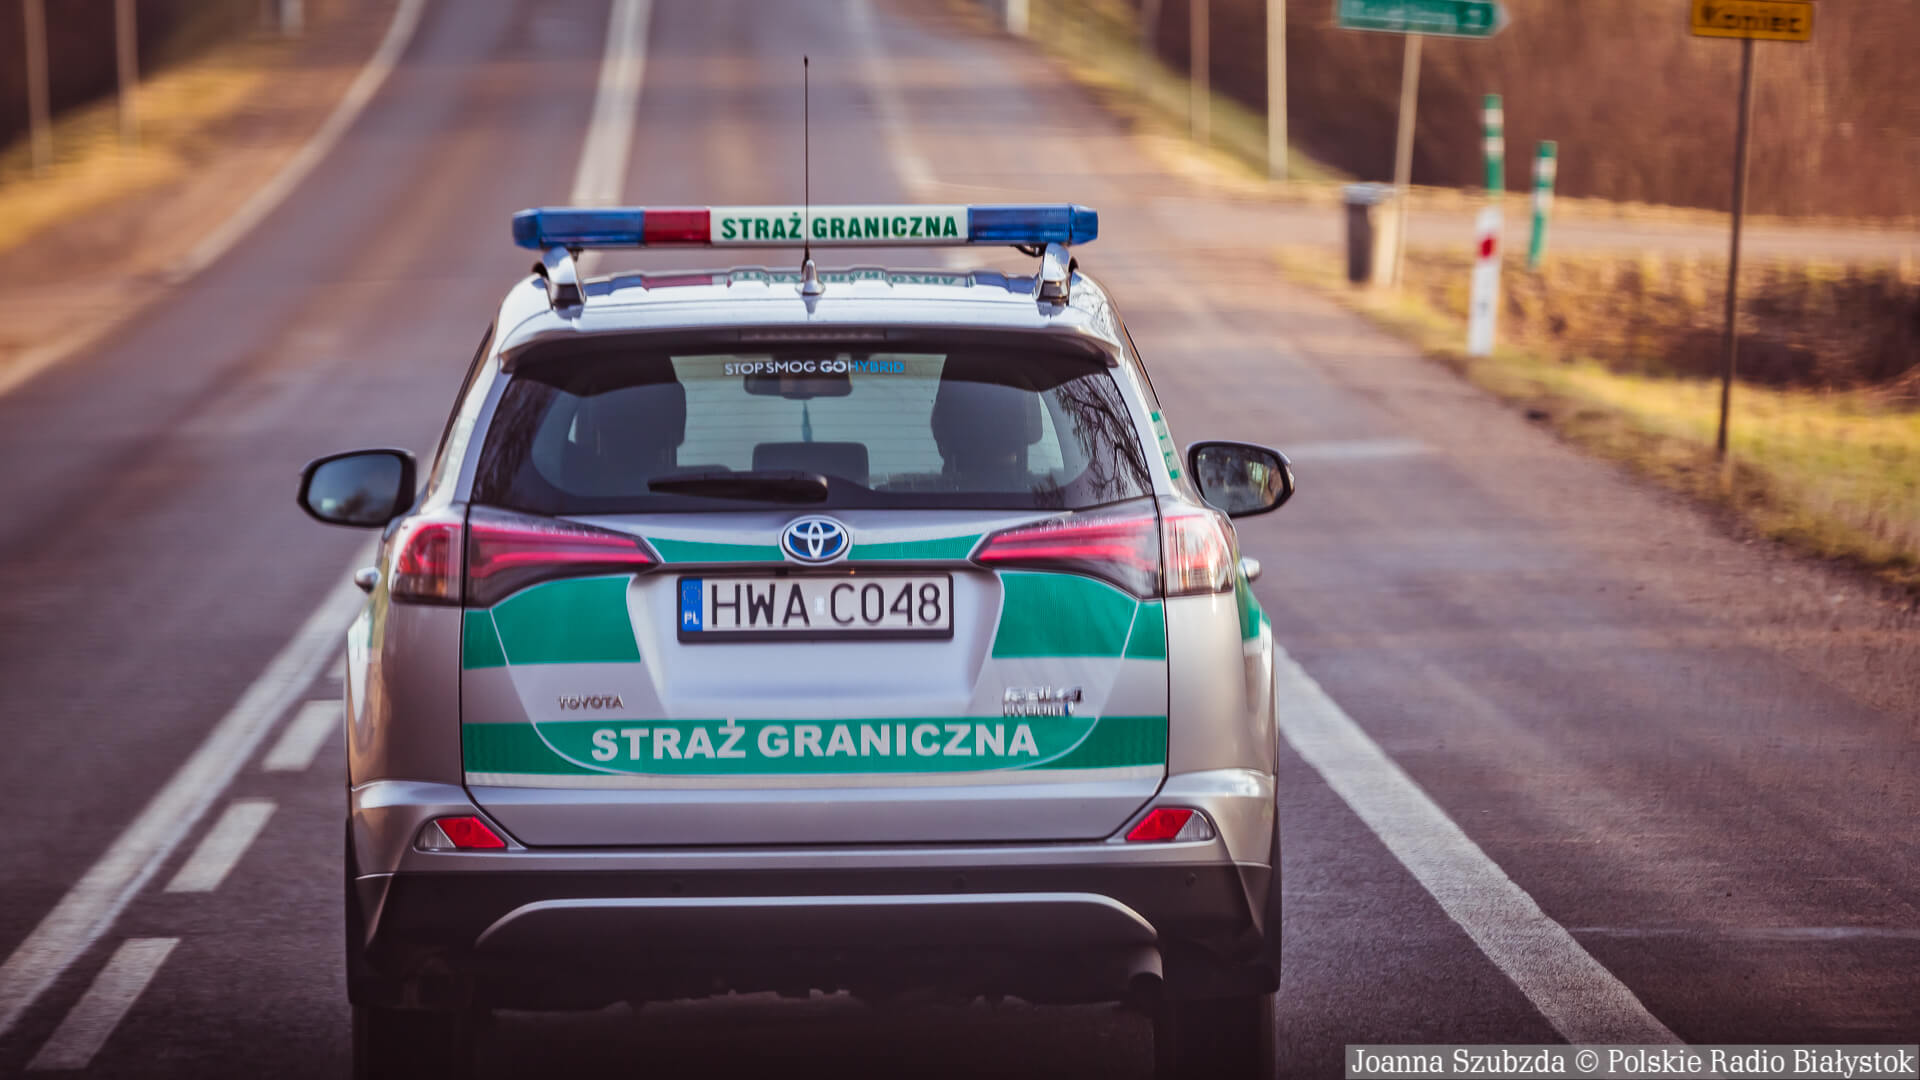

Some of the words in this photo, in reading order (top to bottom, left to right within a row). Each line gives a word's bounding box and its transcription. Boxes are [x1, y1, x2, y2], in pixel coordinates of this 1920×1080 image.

[721, 212, 802, 239] STRAŻ
[812, 216, 958, 238] GRANICZNA
[766, 360, 816, 374] SMOG
[711, 583, 811, 628] HWA
[684, 610, 700, 625] PL
[559, 695, 624, 711] TOYOTA
[591, 717, 747, 762] STRAŻ
[757, 723, 1040, 758] GRANICZNA
